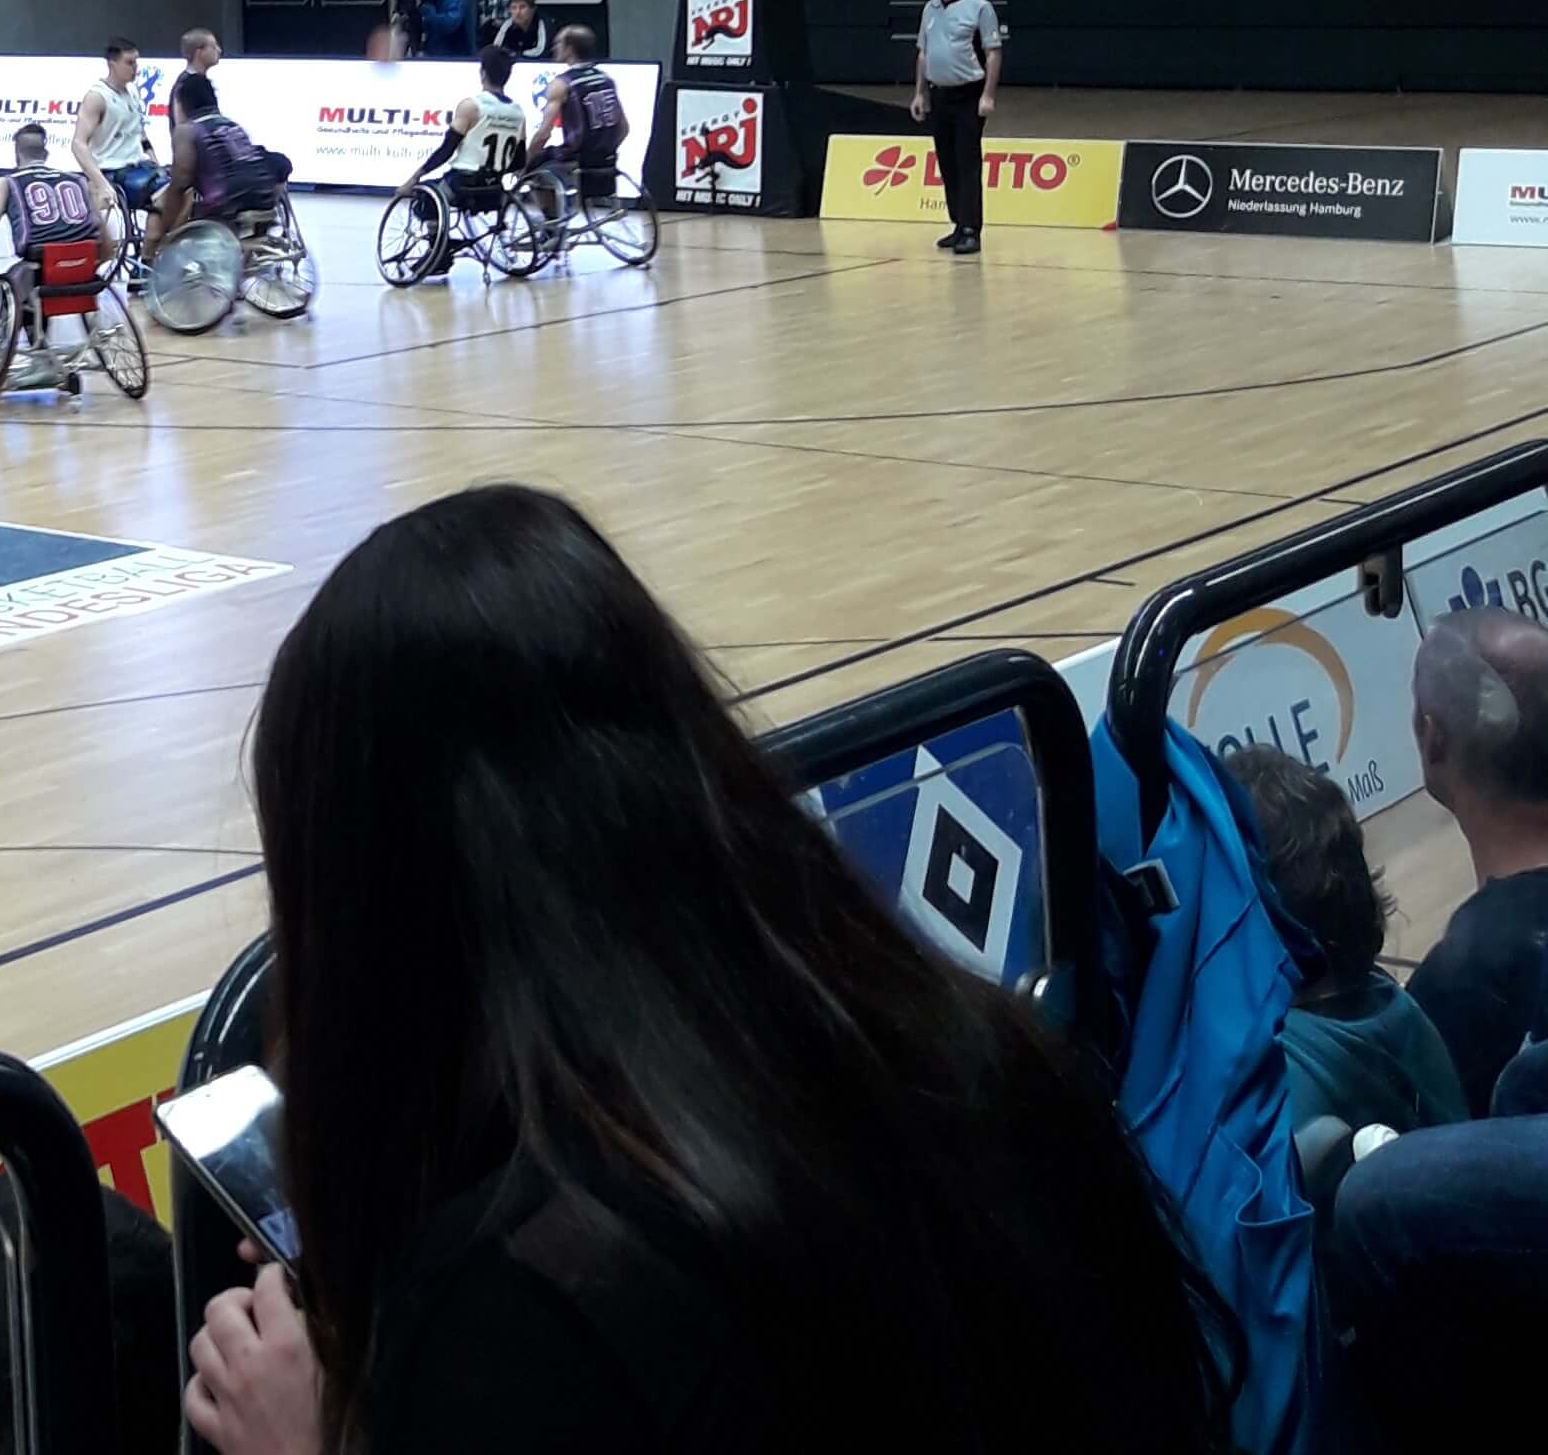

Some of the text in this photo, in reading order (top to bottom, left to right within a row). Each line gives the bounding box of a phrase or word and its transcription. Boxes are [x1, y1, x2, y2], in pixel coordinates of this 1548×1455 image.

[318, 106, 454, 126] MULTI-K
[923, 151, 1068, 191] LTTO
[1228, 168, 1405, 196] Mercedes-Benz
[24, 180, 88, 225] 90
[1227, 199, 1362, 219] Niederlassung Hamburg
